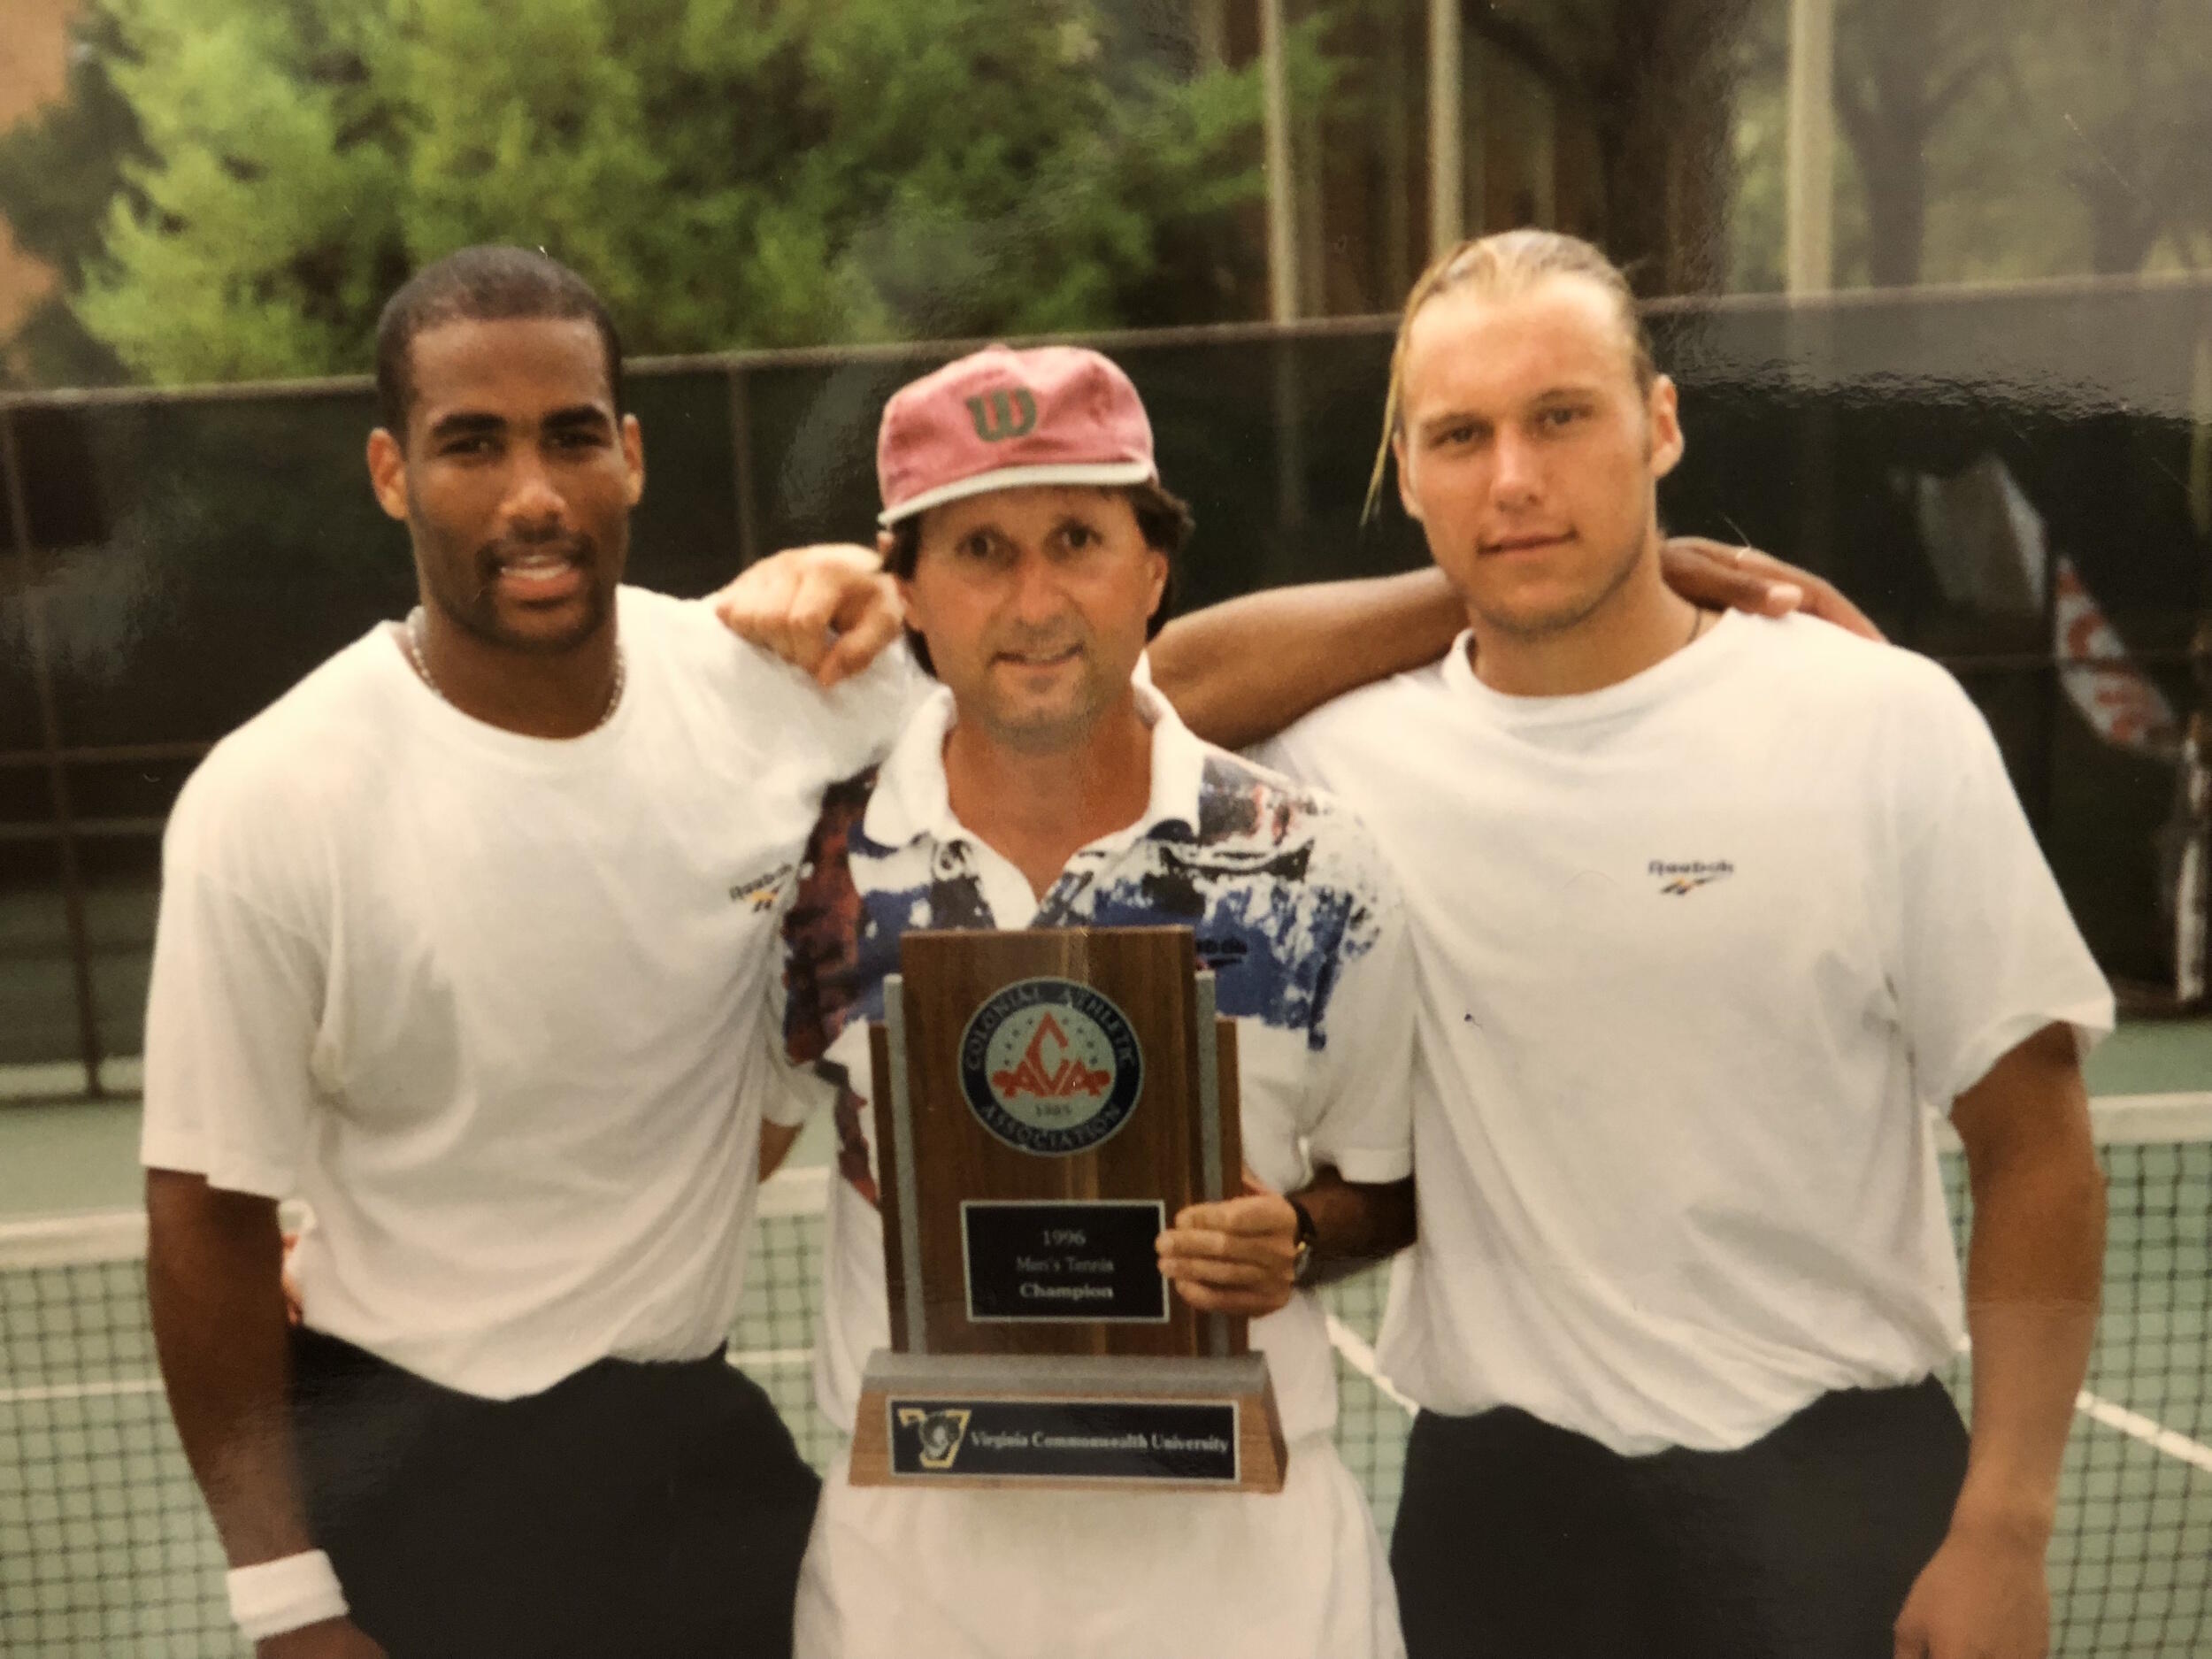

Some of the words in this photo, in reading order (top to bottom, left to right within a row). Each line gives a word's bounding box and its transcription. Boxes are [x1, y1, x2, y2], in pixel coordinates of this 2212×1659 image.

[966, 985, 1041, 1071] COLONIAL
[1059, 987, 1133, 1067] ATHLETIC
[982, 1104, 1121, 1149] ASSOCIATION
[1042, 1228, 1087, 1248] 1996
[1016, 1256, 1062, 1272] Men's
[1065, 1256, 1115, 1273] Tennis
[1018, 1282, 1115, 1302] Champion
[971, 1430, 1029, 1450] Virginia
[1031, 1431, 1148, 1449] Commonwealth
[1151, 1432, 1229, 1455] University
